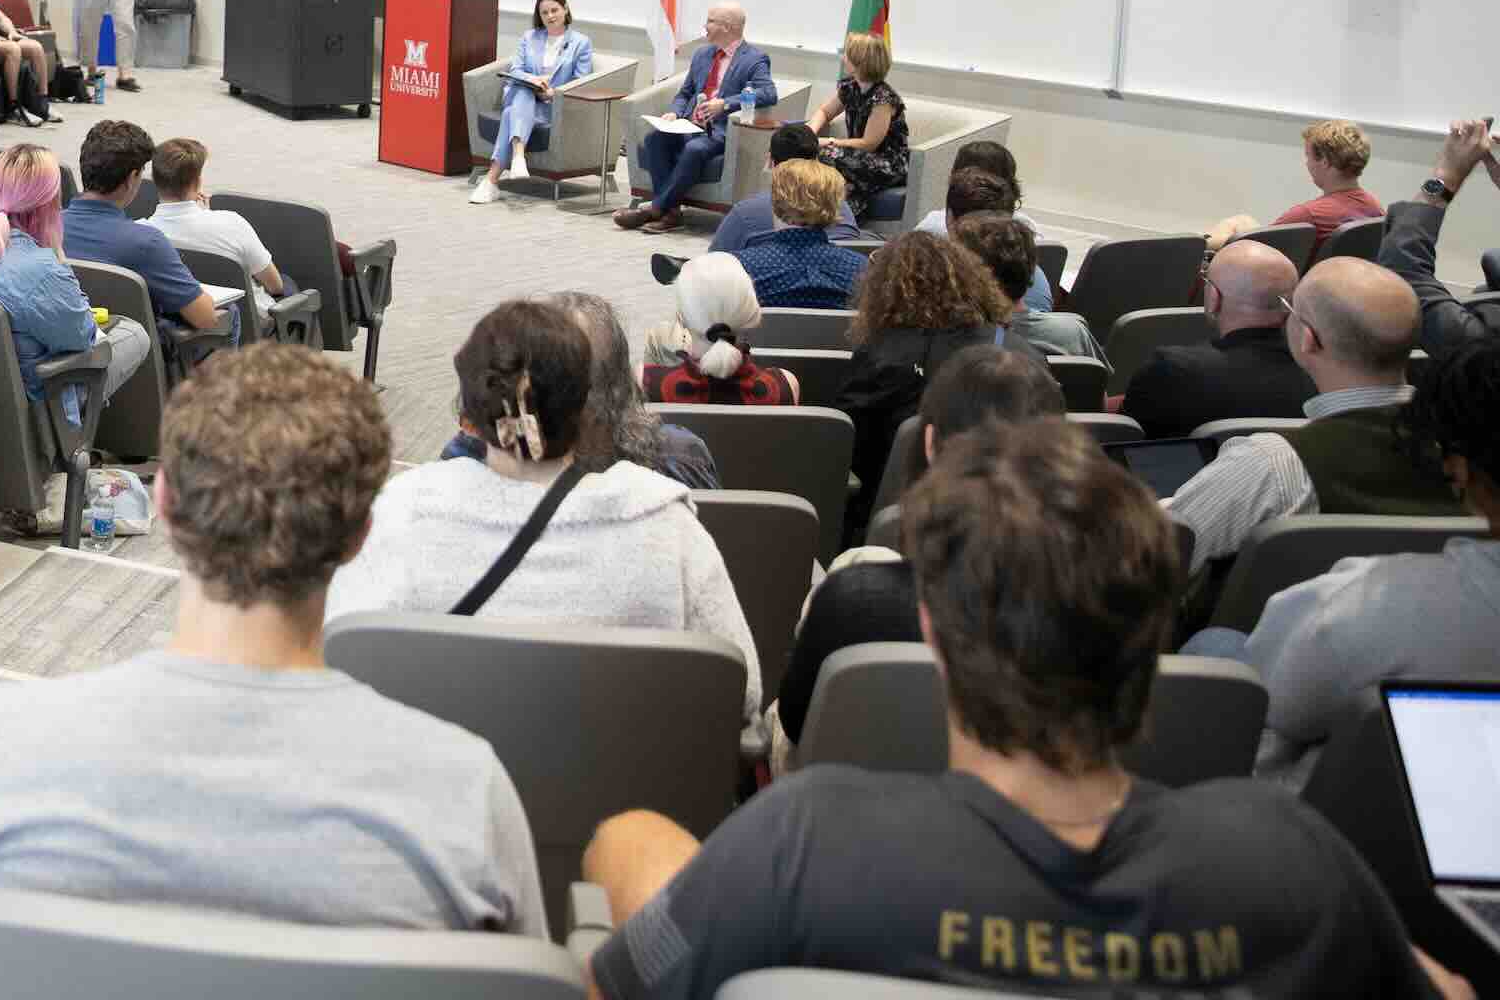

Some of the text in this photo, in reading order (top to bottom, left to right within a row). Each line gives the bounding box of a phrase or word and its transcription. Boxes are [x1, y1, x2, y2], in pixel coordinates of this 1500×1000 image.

[404, 39, 428, 68] M
[390, 65, 440, 88] MIAMI
[390, 81, 439, 98] UNIVERSITY
[938, 909, 1242, 982] FREEDOM
